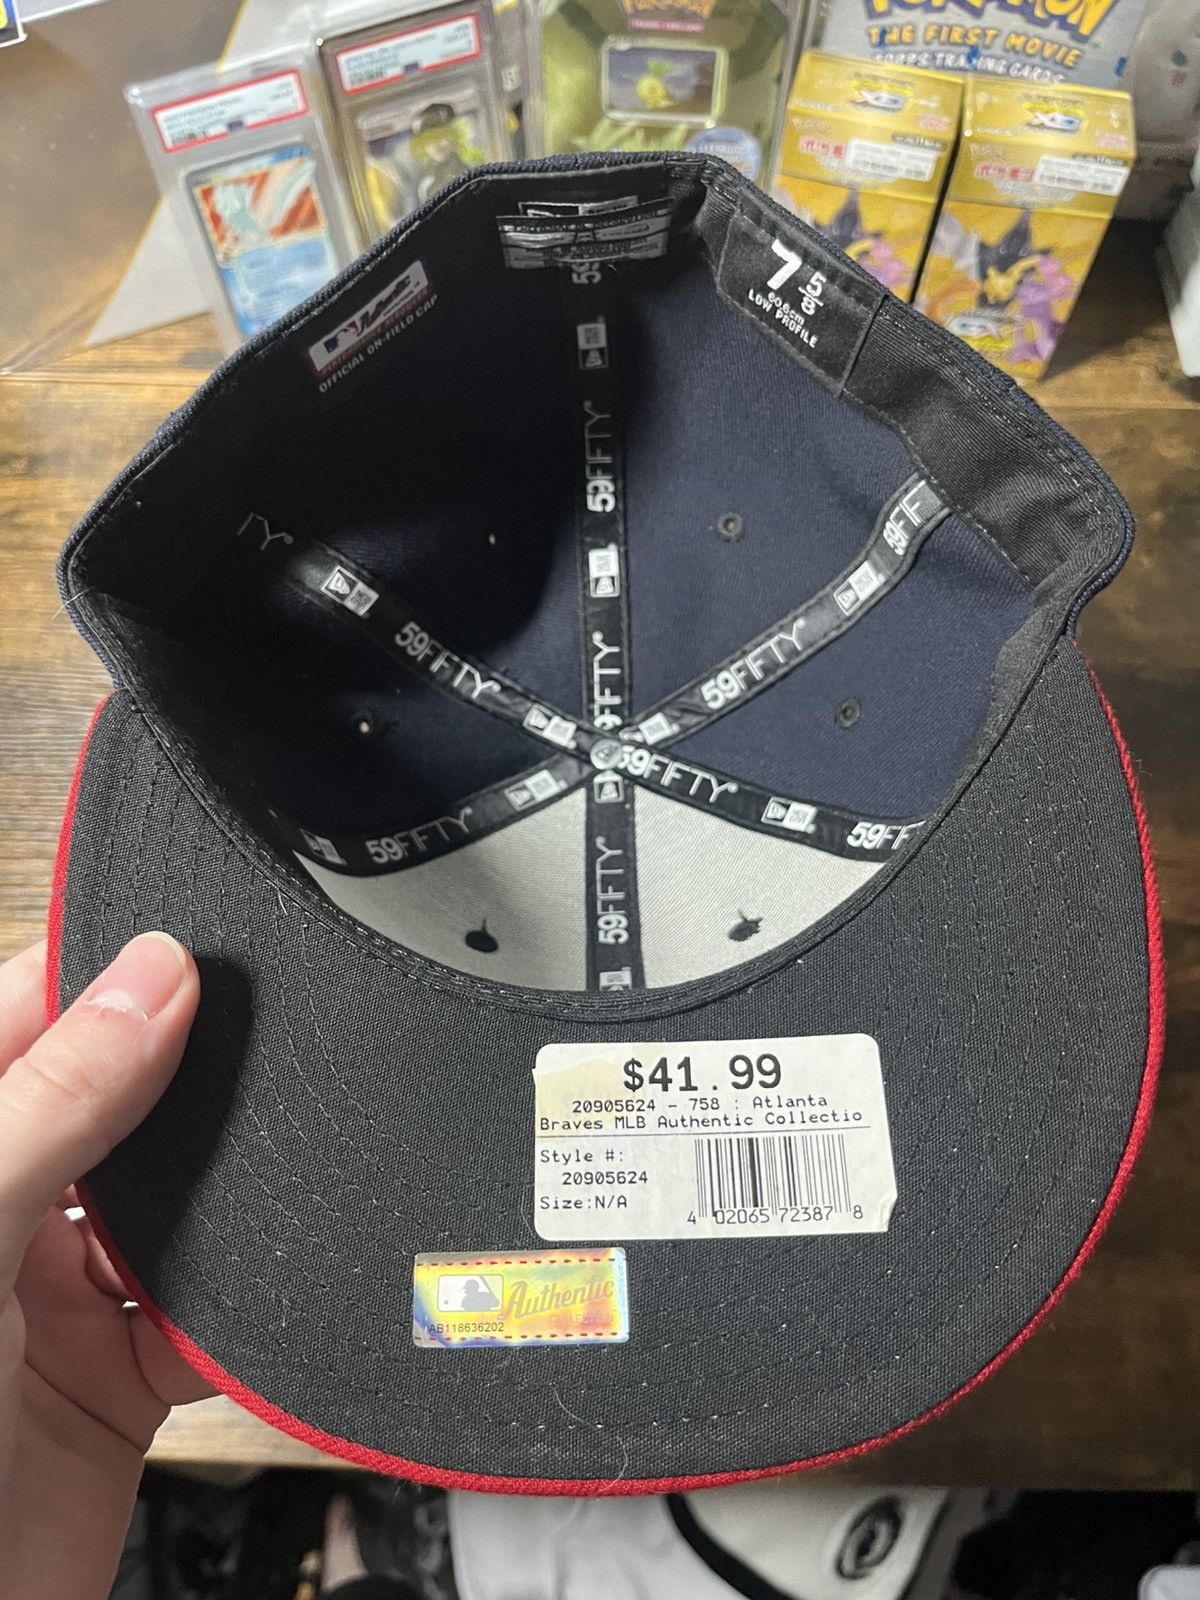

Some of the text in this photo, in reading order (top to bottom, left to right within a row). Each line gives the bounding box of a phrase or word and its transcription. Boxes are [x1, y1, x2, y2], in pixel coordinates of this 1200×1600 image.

[922, 23, 998, 48] FIRST
[1005, 32, 1083, 69] MOVIE
[767, 239, 802, 290] 7
[748, 288, 818, 348] LOW PROFILE
[767, 292, 805, 326] 60.6cm
[319, 353, 365, 393] OFFICIAL
[415, 294, 438, 317] CAP
[623, 1053, 782, 1092] $41.99
[540, 1110, 862, 1131] Braves MLB Authentic Collectio
[572, 1099, 656, 1114] 20905624
[688, 1097, 720, 1111] 758
[752, 1094, 828, 1108] Atlanta
[540, 1150, 593, 1166] Style
[562, 1171, 648, 1185] 20905624
[540, 1195, 628, 1210] Size:N/A
[687, 1206, 864, 1225] 4 02065 72387 8
[497, 1279, 614, 1320] Authentic
